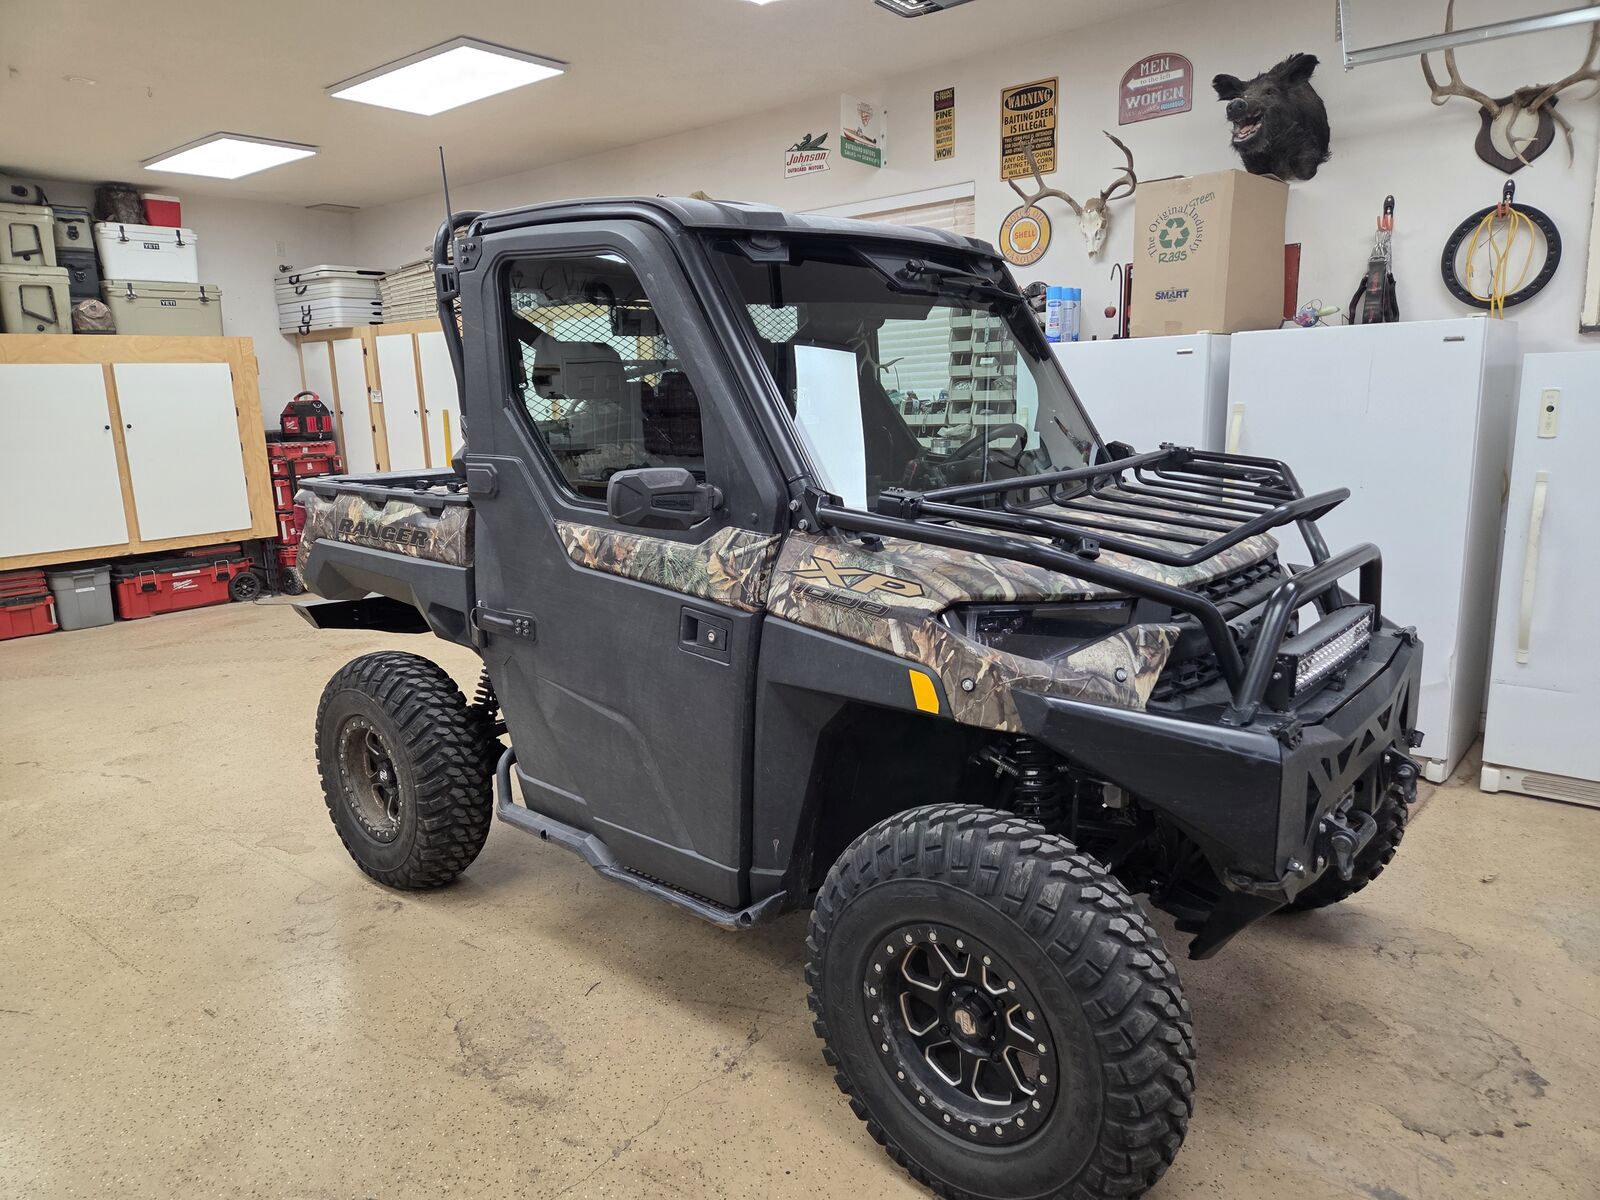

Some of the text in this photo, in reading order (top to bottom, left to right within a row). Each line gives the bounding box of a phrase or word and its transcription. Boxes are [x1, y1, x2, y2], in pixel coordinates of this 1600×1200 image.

[1140, 57, 1169, 76] MEN
[1007, 90, 1050, 108] WARNING
[1125, 86, 1184, 109] WOMEN
[936, 109, 952, 120] FINE
[1004, 108, 1054, 126] BAITING DEER
[1010, 119, 1046, 134] IS ILLEGAL
[786, 152, 826, 166] Johnson
[1004, 162, 1023, 170] EATING
[1005, 208, 1045, 229] MOTR OIL
[1147, 192, 1216, 258] The Original Green Industry
[1014, 230, 1035, 239] SHELL
[1005, 246, 1044, 263] GASOLINE
[1158, 250, 1187, 263] Rags
[1155, 289, 1189, 300] SMART
[338, 519, 429, 548] RANGER
[781, 555, 925, 598] XP
[793, 582, 890, 616] 1000
